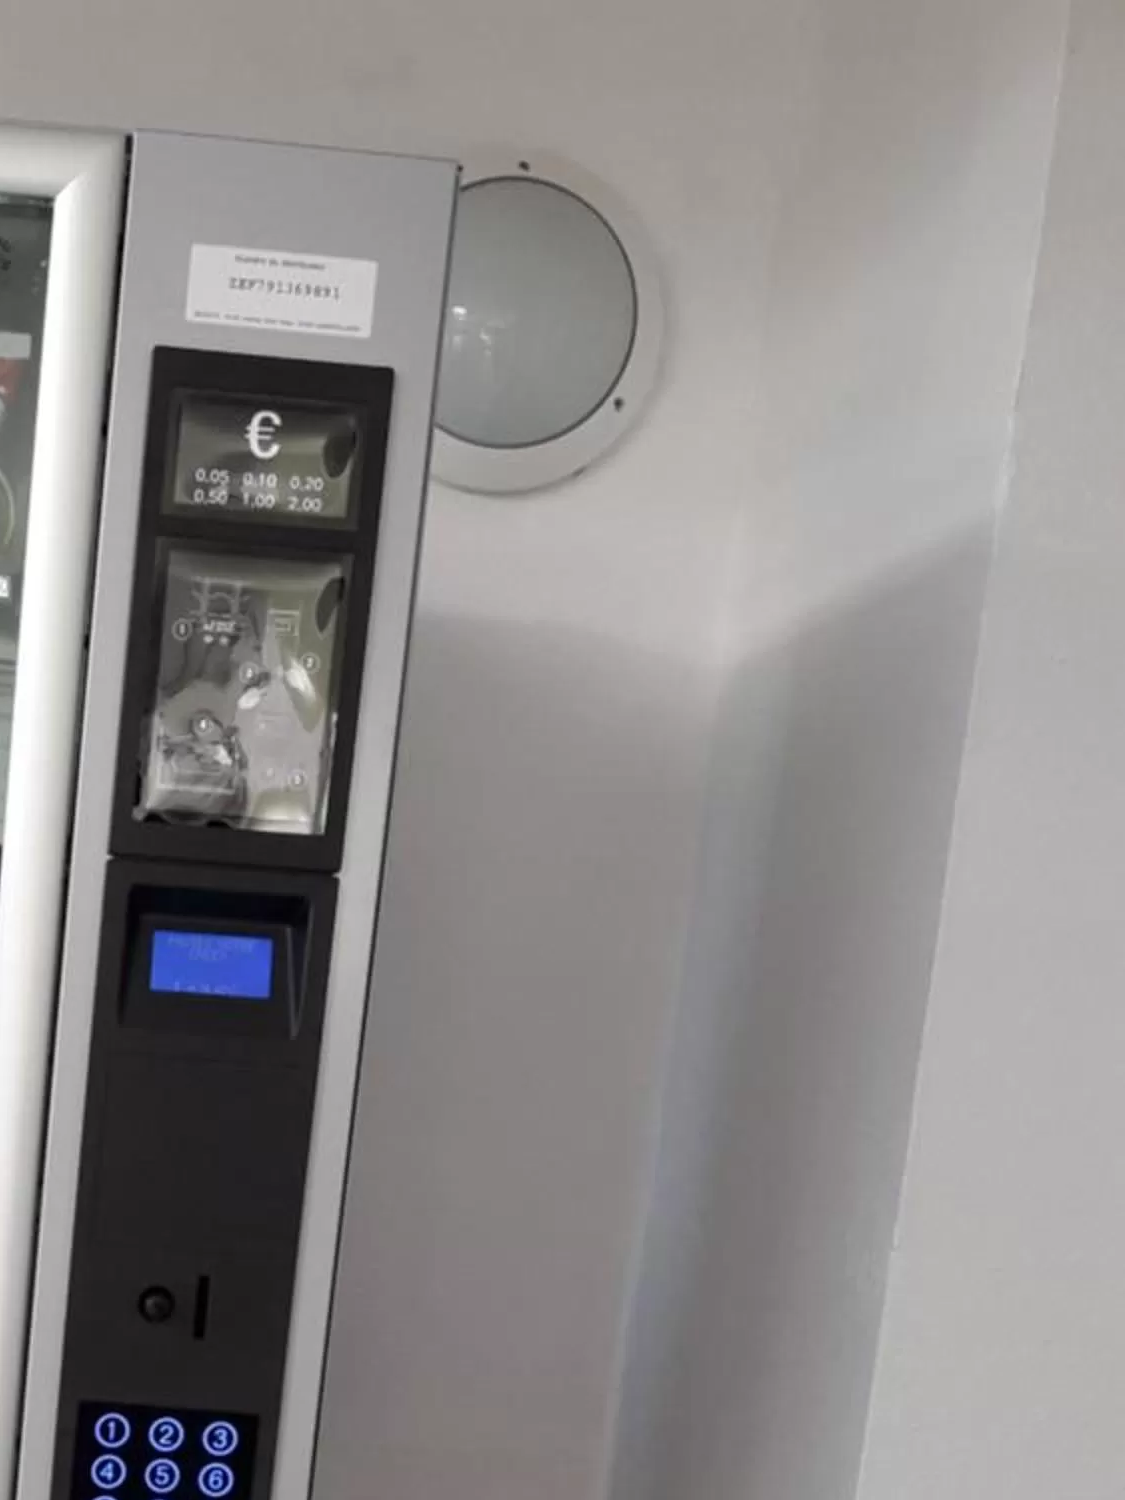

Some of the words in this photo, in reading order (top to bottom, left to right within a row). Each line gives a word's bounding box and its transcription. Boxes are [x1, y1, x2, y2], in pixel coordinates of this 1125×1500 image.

[195, 468, 229, 486] 0.05
[243, 472, 277, 488] 0.10
[289, 476, 324, 491] 0.20
[194, 489, 227, 505] 0.50
[242, 492, 275, 508] 1.00
[288, 496, 322, 512] 2.00
[159, 1424, 174, 1445] 2
[212, 1429, 228, 1448] 3
[99, 1461, 114, 1481] 4
[154, 1466, 169, 1485] 5
[207, 1470, 223, 1490] 6
